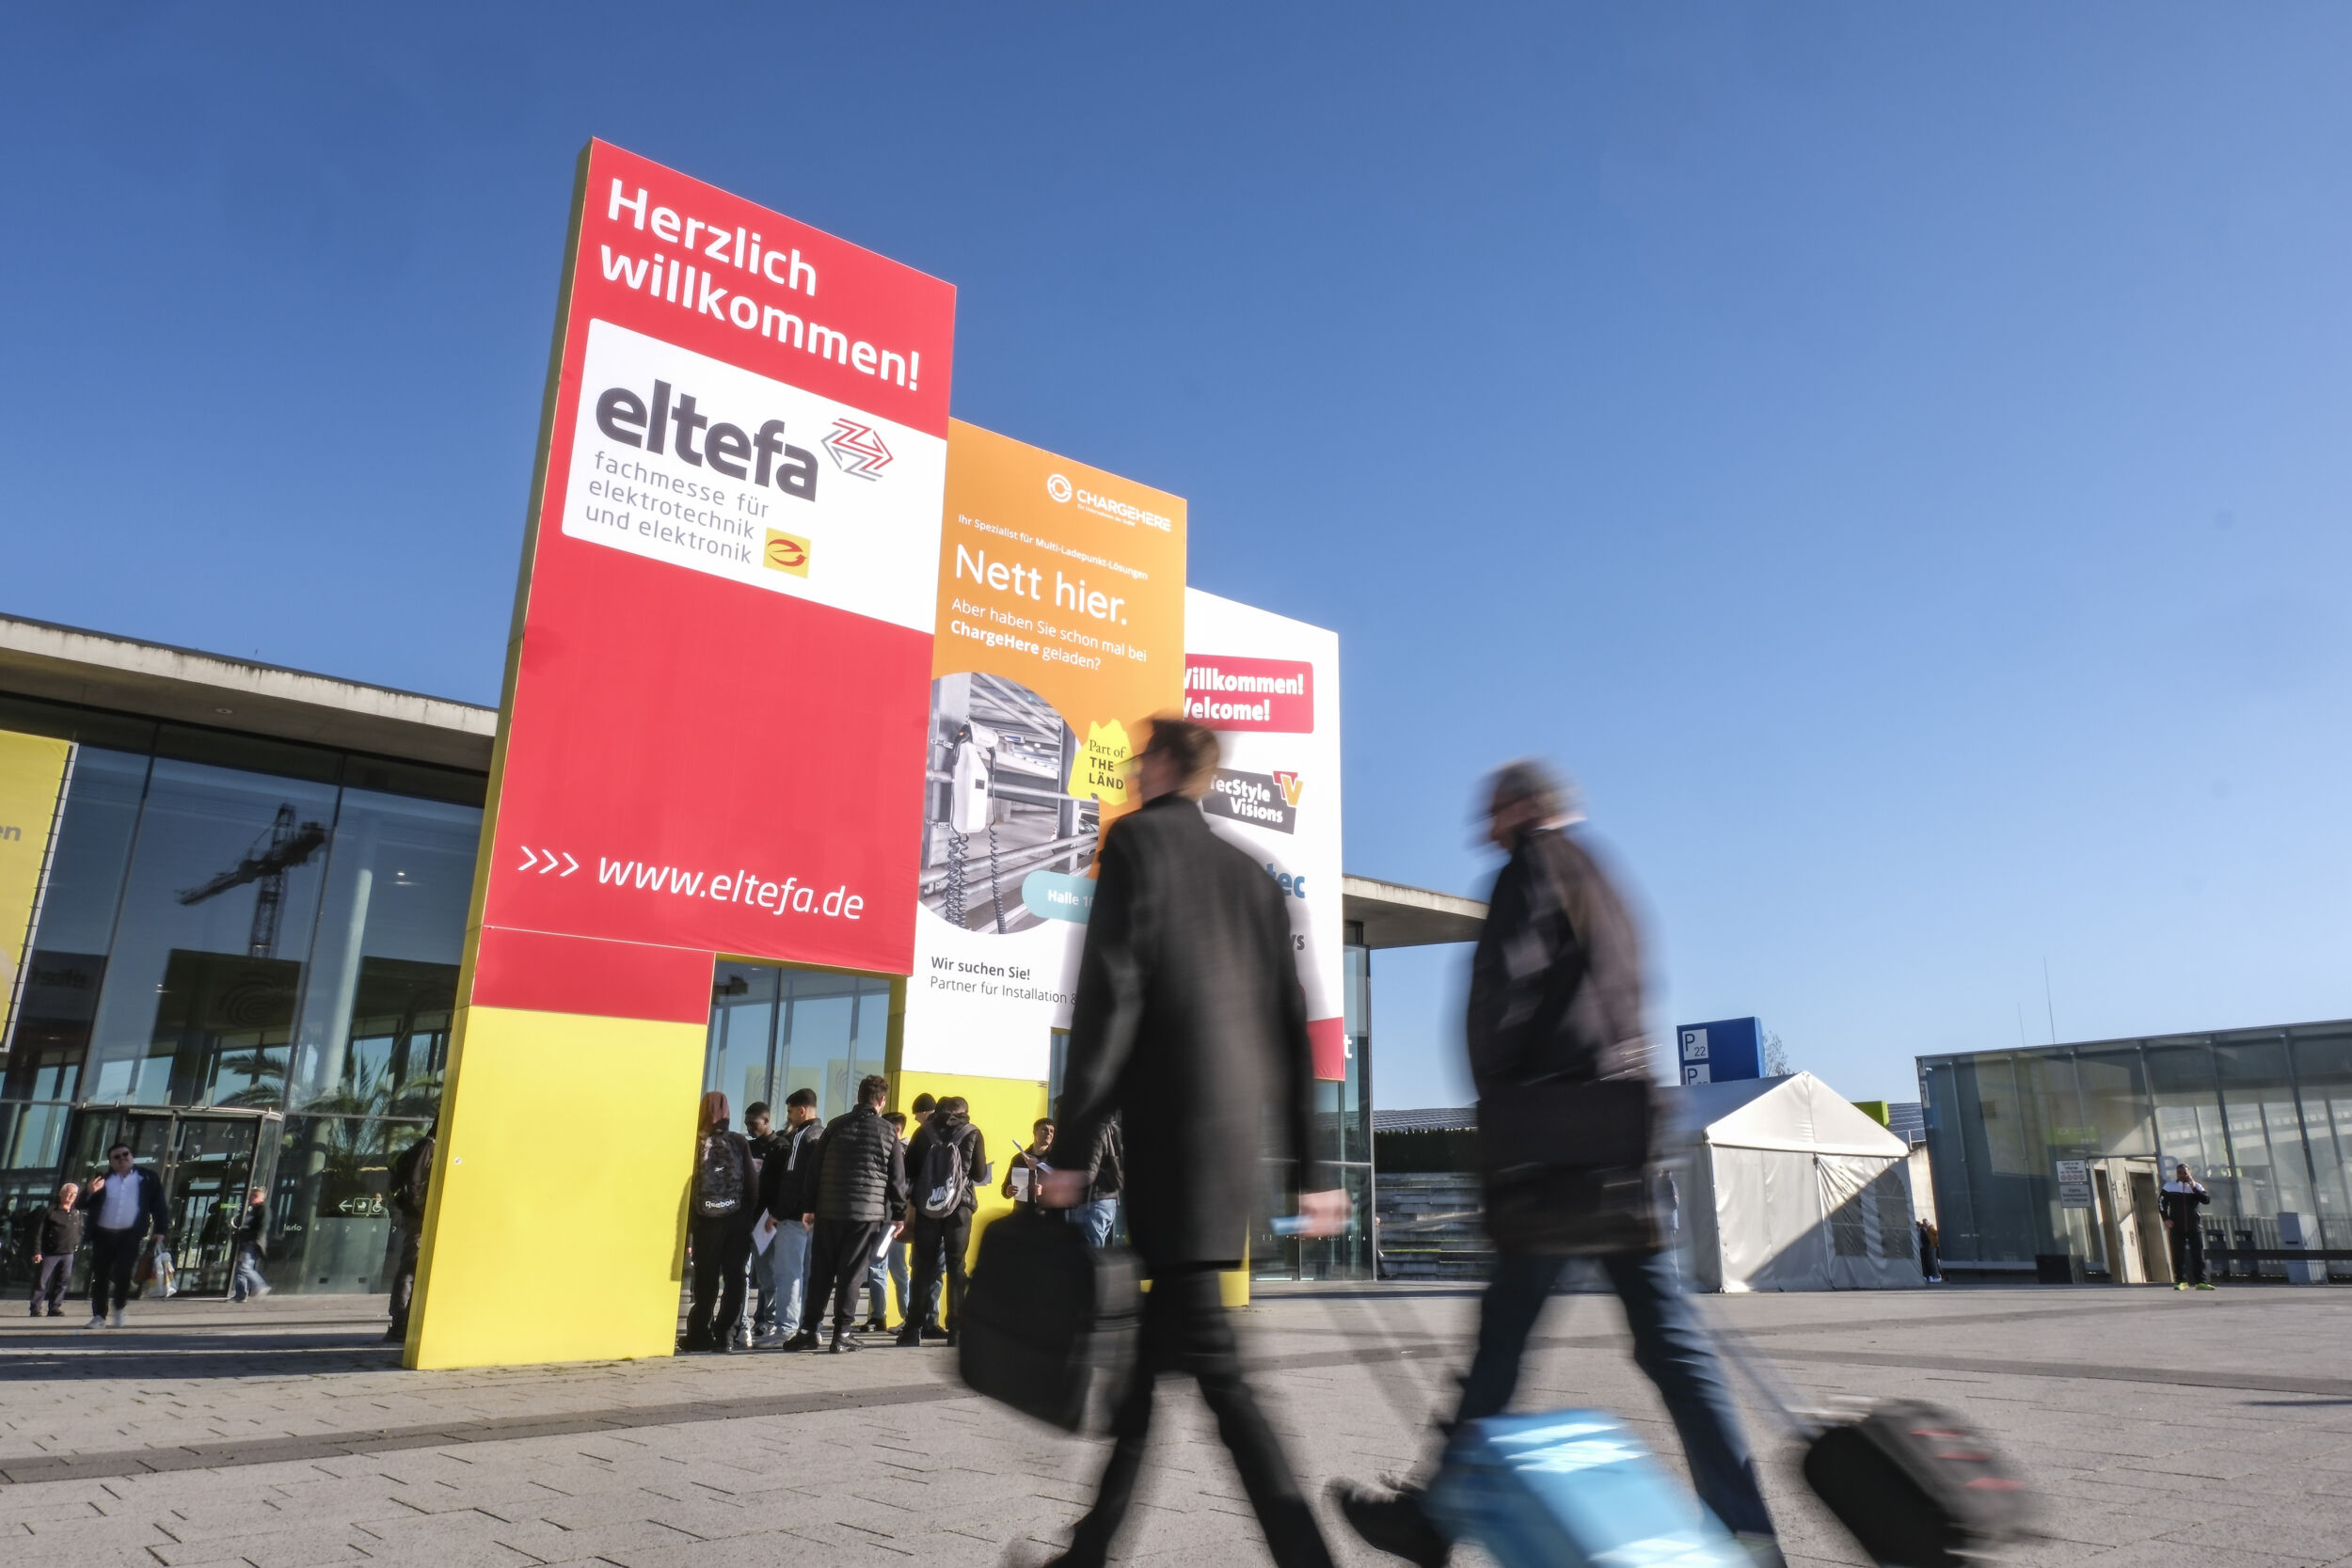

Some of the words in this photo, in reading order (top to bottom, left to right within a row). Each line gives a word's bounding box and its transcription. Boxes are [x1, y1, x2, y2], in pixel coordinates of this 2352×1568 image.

[608, 178, 818, 296] Herzlich
[600, 245, 920, 391] willkommen!
[596, 378, 818, 502] eltefa
[588, 480, 755, 539] elektrotechnik
[594, 451, 725, 506] fachmesse
[737, 493, 770, 518] für
[1076, 489, 1171, 532] CHARGEHERE
[585, 505, 629, 531] und
[639, 520, 752, 564] elektronik
[958, 515, 972, 526] Ihr
[975, 519, 1018, 540] Spezialist
[1020, 532, 1033, 545] für
[1035, 538, 1148, 581] Multi-Ladepunkt-Lösungen
[956, 544, 1041, 600] Nett
[1056, 571, 1127, 626] hier.
[950, 620, 1040, 654] ChargeHere
[1041, 644, 1101, 671] geladen?
[951, 597, 986, 618] Aber
[990, 607, 1033, 632] haben
[1037, 620, 1057, 638] Sie
[1059, 626, 1099, 649] schon
[1102, 638, 1125, 657] mal
[1128, 645, 1147, 662] bei
[1089, 739, 1111, 755] Part
[1113, 747, 1126, 758] of
[1089, 756, 1114, 772] THE
[1089, 771, 1123, 790] LÄND
[1230, 797, 1283, 823] Visions
[598, 857, 864, 920] www.eltefa.de
[1047, 889, 1079, 906] Halle
[930, 956, 954, 971] Wir
[958, 961, 1005, 977] suchen
[1009, 967, 1030, 980] Sie!
[930, 975, 977, 993] Partner
[981, 981, 998, 995] für
[1002, 985, 1067, 1004] Installation
[705, 1199, 736, 1209] Reebok
